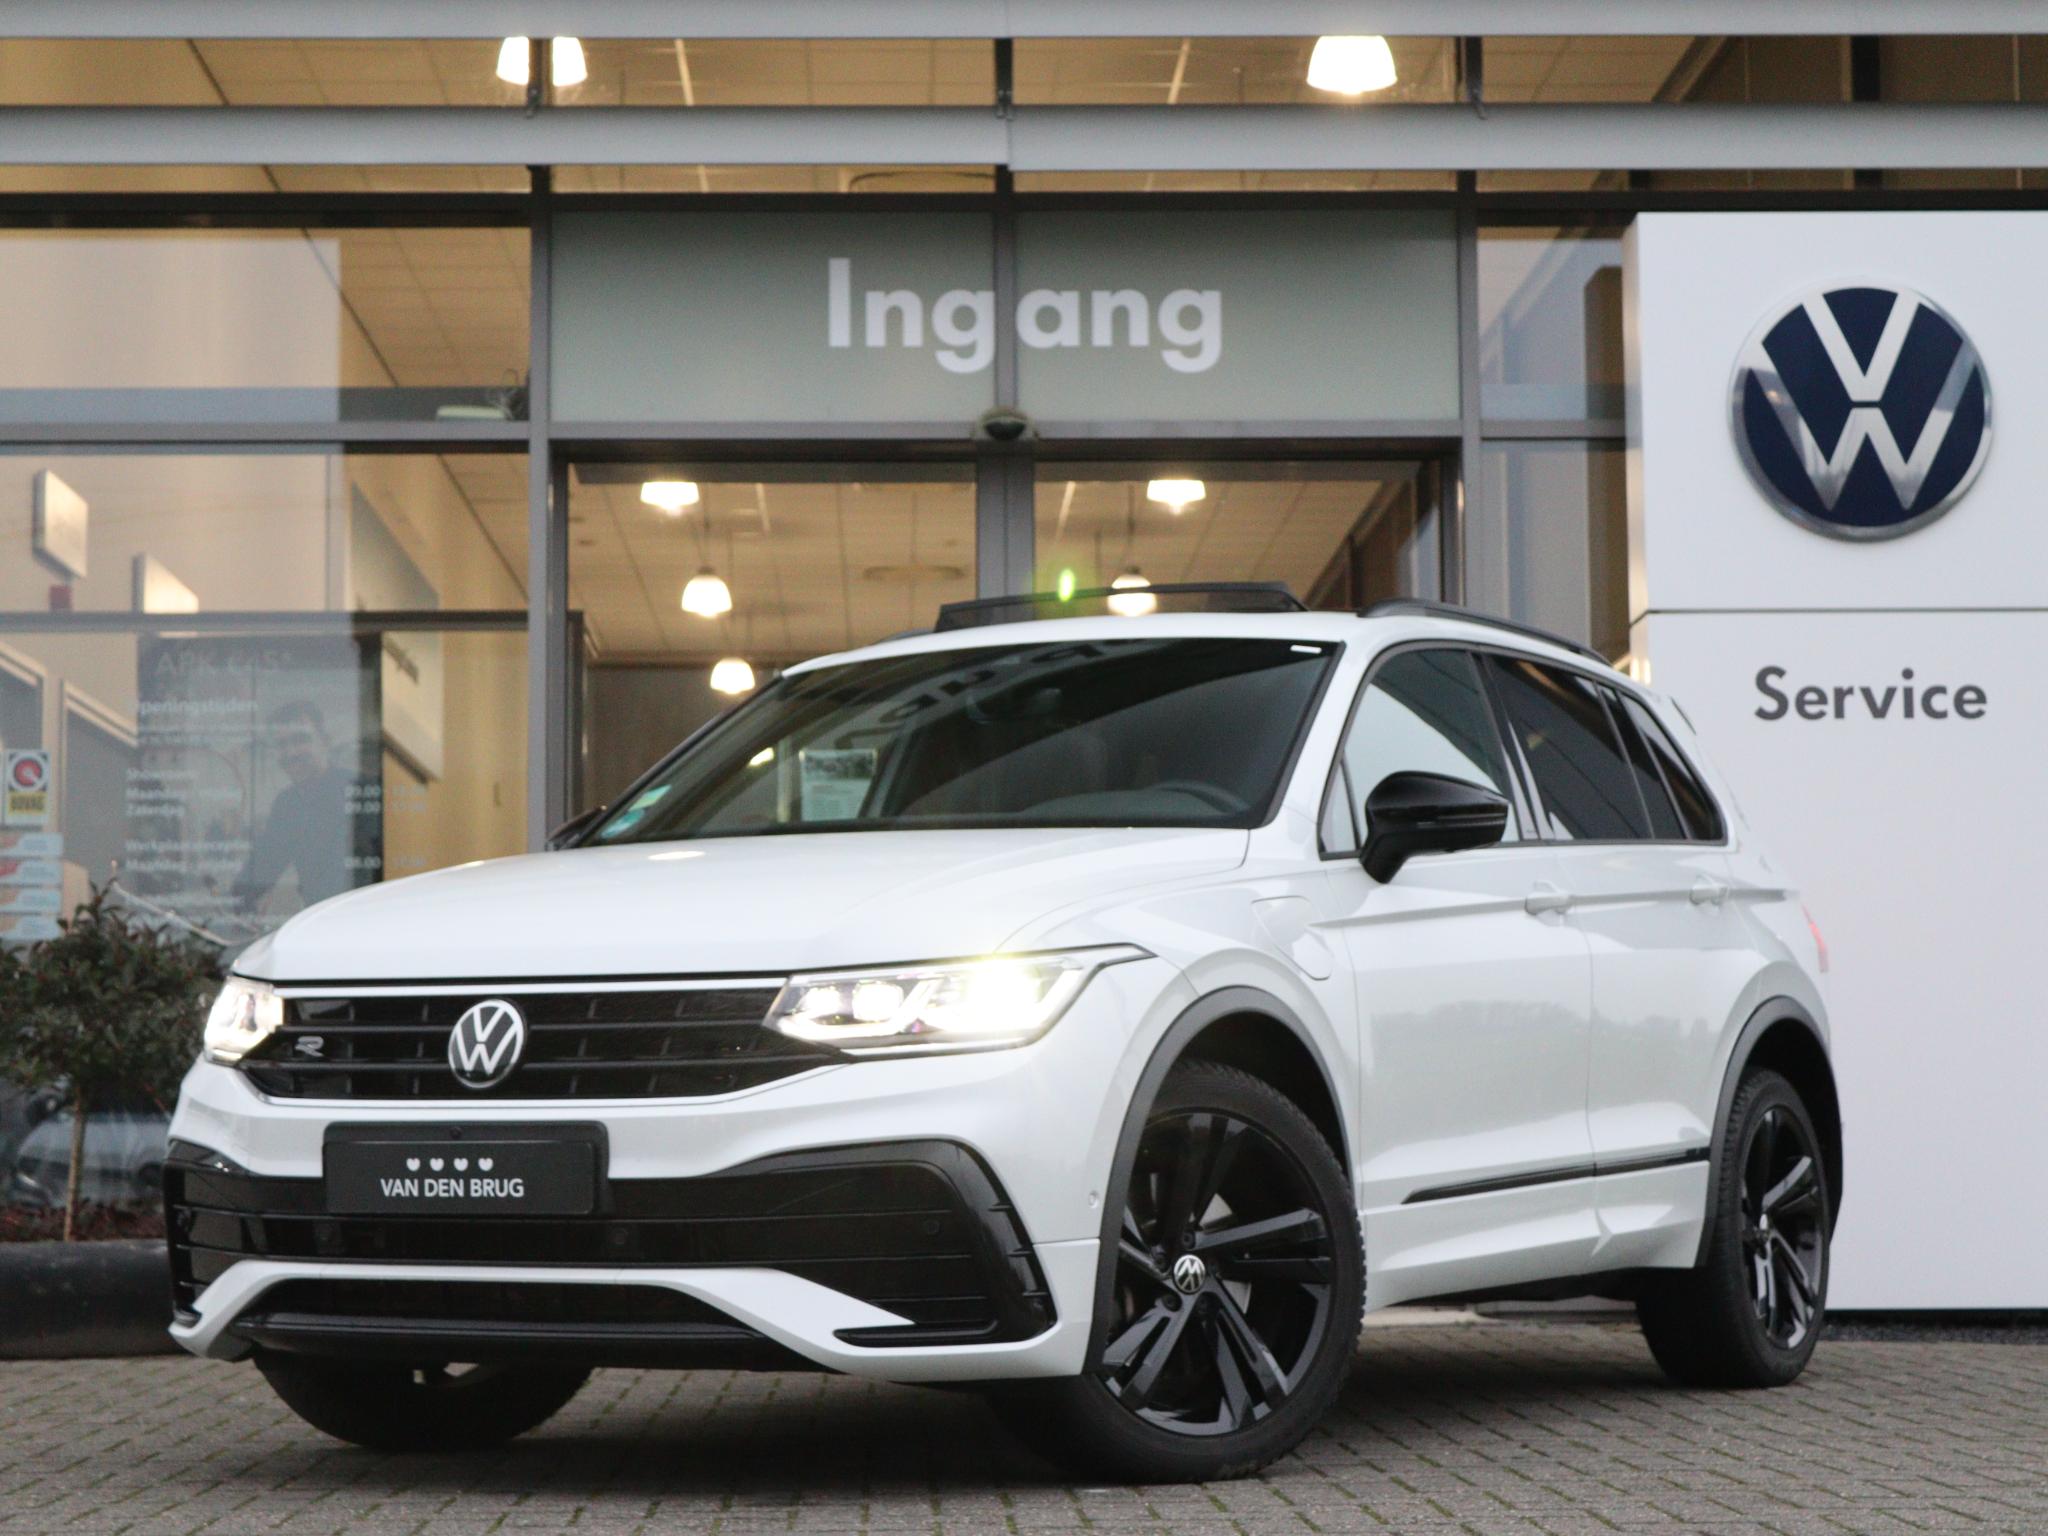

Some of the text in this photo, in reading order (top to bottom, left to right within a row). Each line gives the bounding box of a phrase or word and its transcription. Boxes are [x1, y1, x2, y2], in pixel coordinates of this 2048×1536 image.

[828, 257, 1221, 374] Ingang
[1754, 665, 1988, 721] Service
[380, 1178, 524, 1198] VAN DEN BRUG
